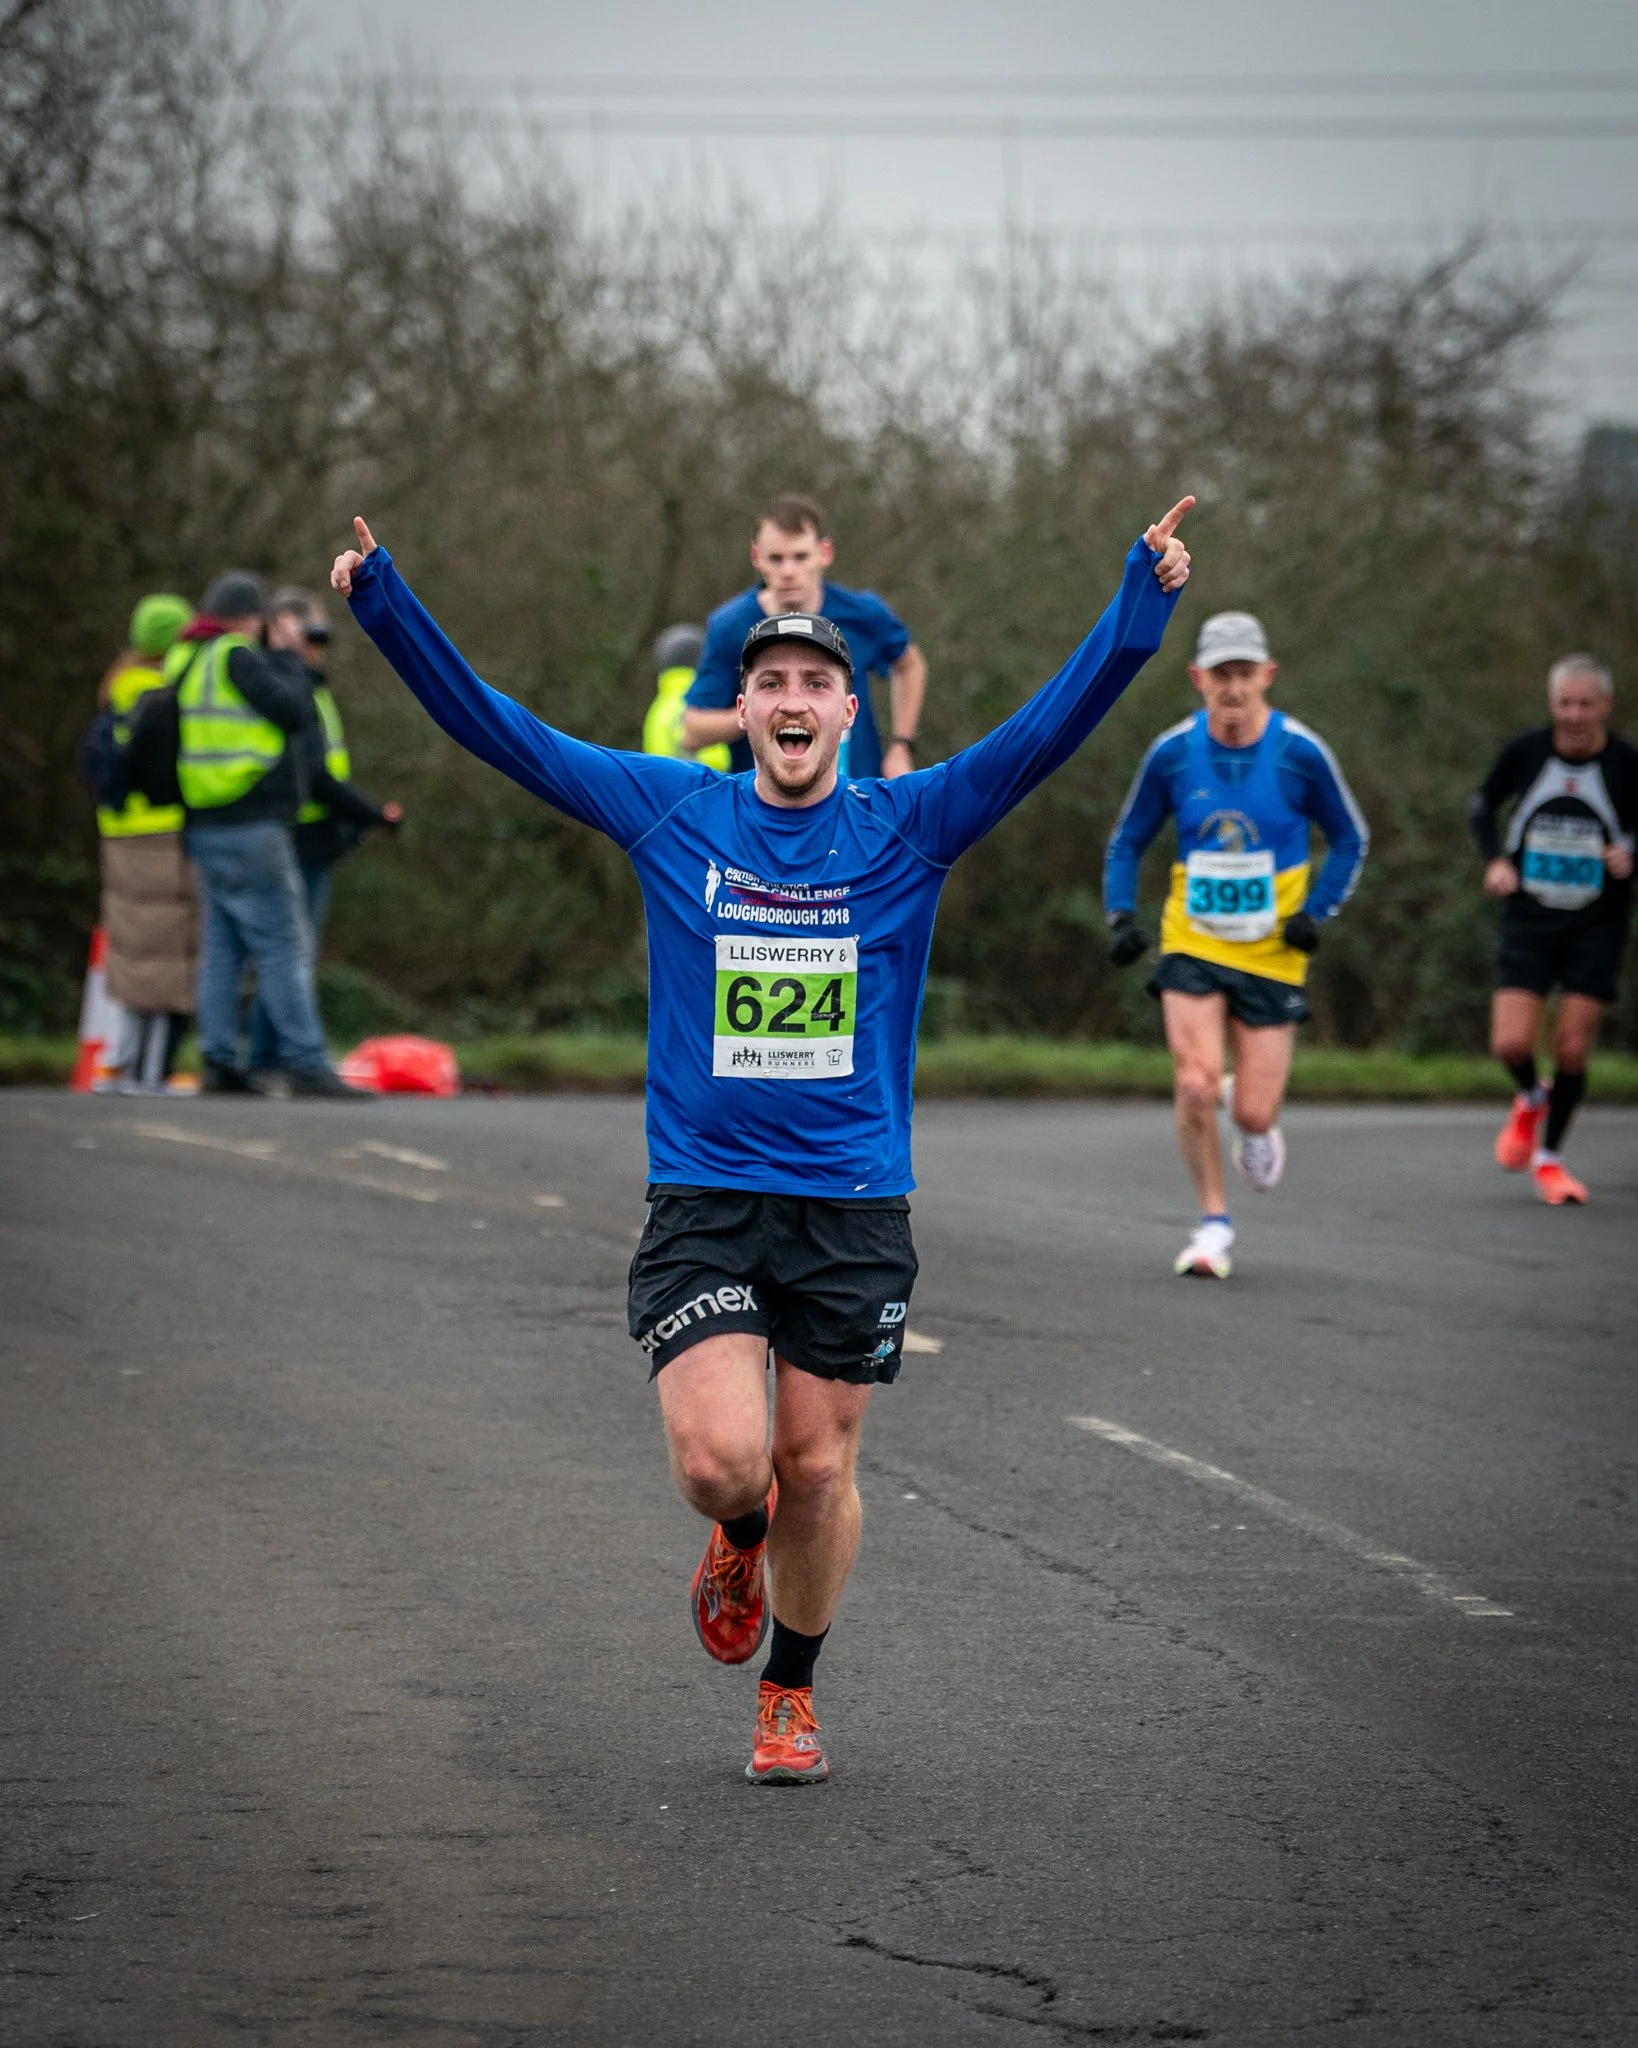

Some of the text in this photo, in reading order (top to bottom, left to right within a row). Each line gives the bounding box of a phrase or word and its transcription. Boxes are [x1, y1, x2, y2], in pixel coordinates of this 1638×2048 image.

[1190, 879, 1266, 914] 399
[717, 902, 818, 925] LOUGHBOROUGH
[822, 908, 850, 925] 2018
[730, 946, 834, 962] LLISWERRY
[726, 976, 846, 1033] 624
[768, 1051, 815, 1059] LLISWERRY
